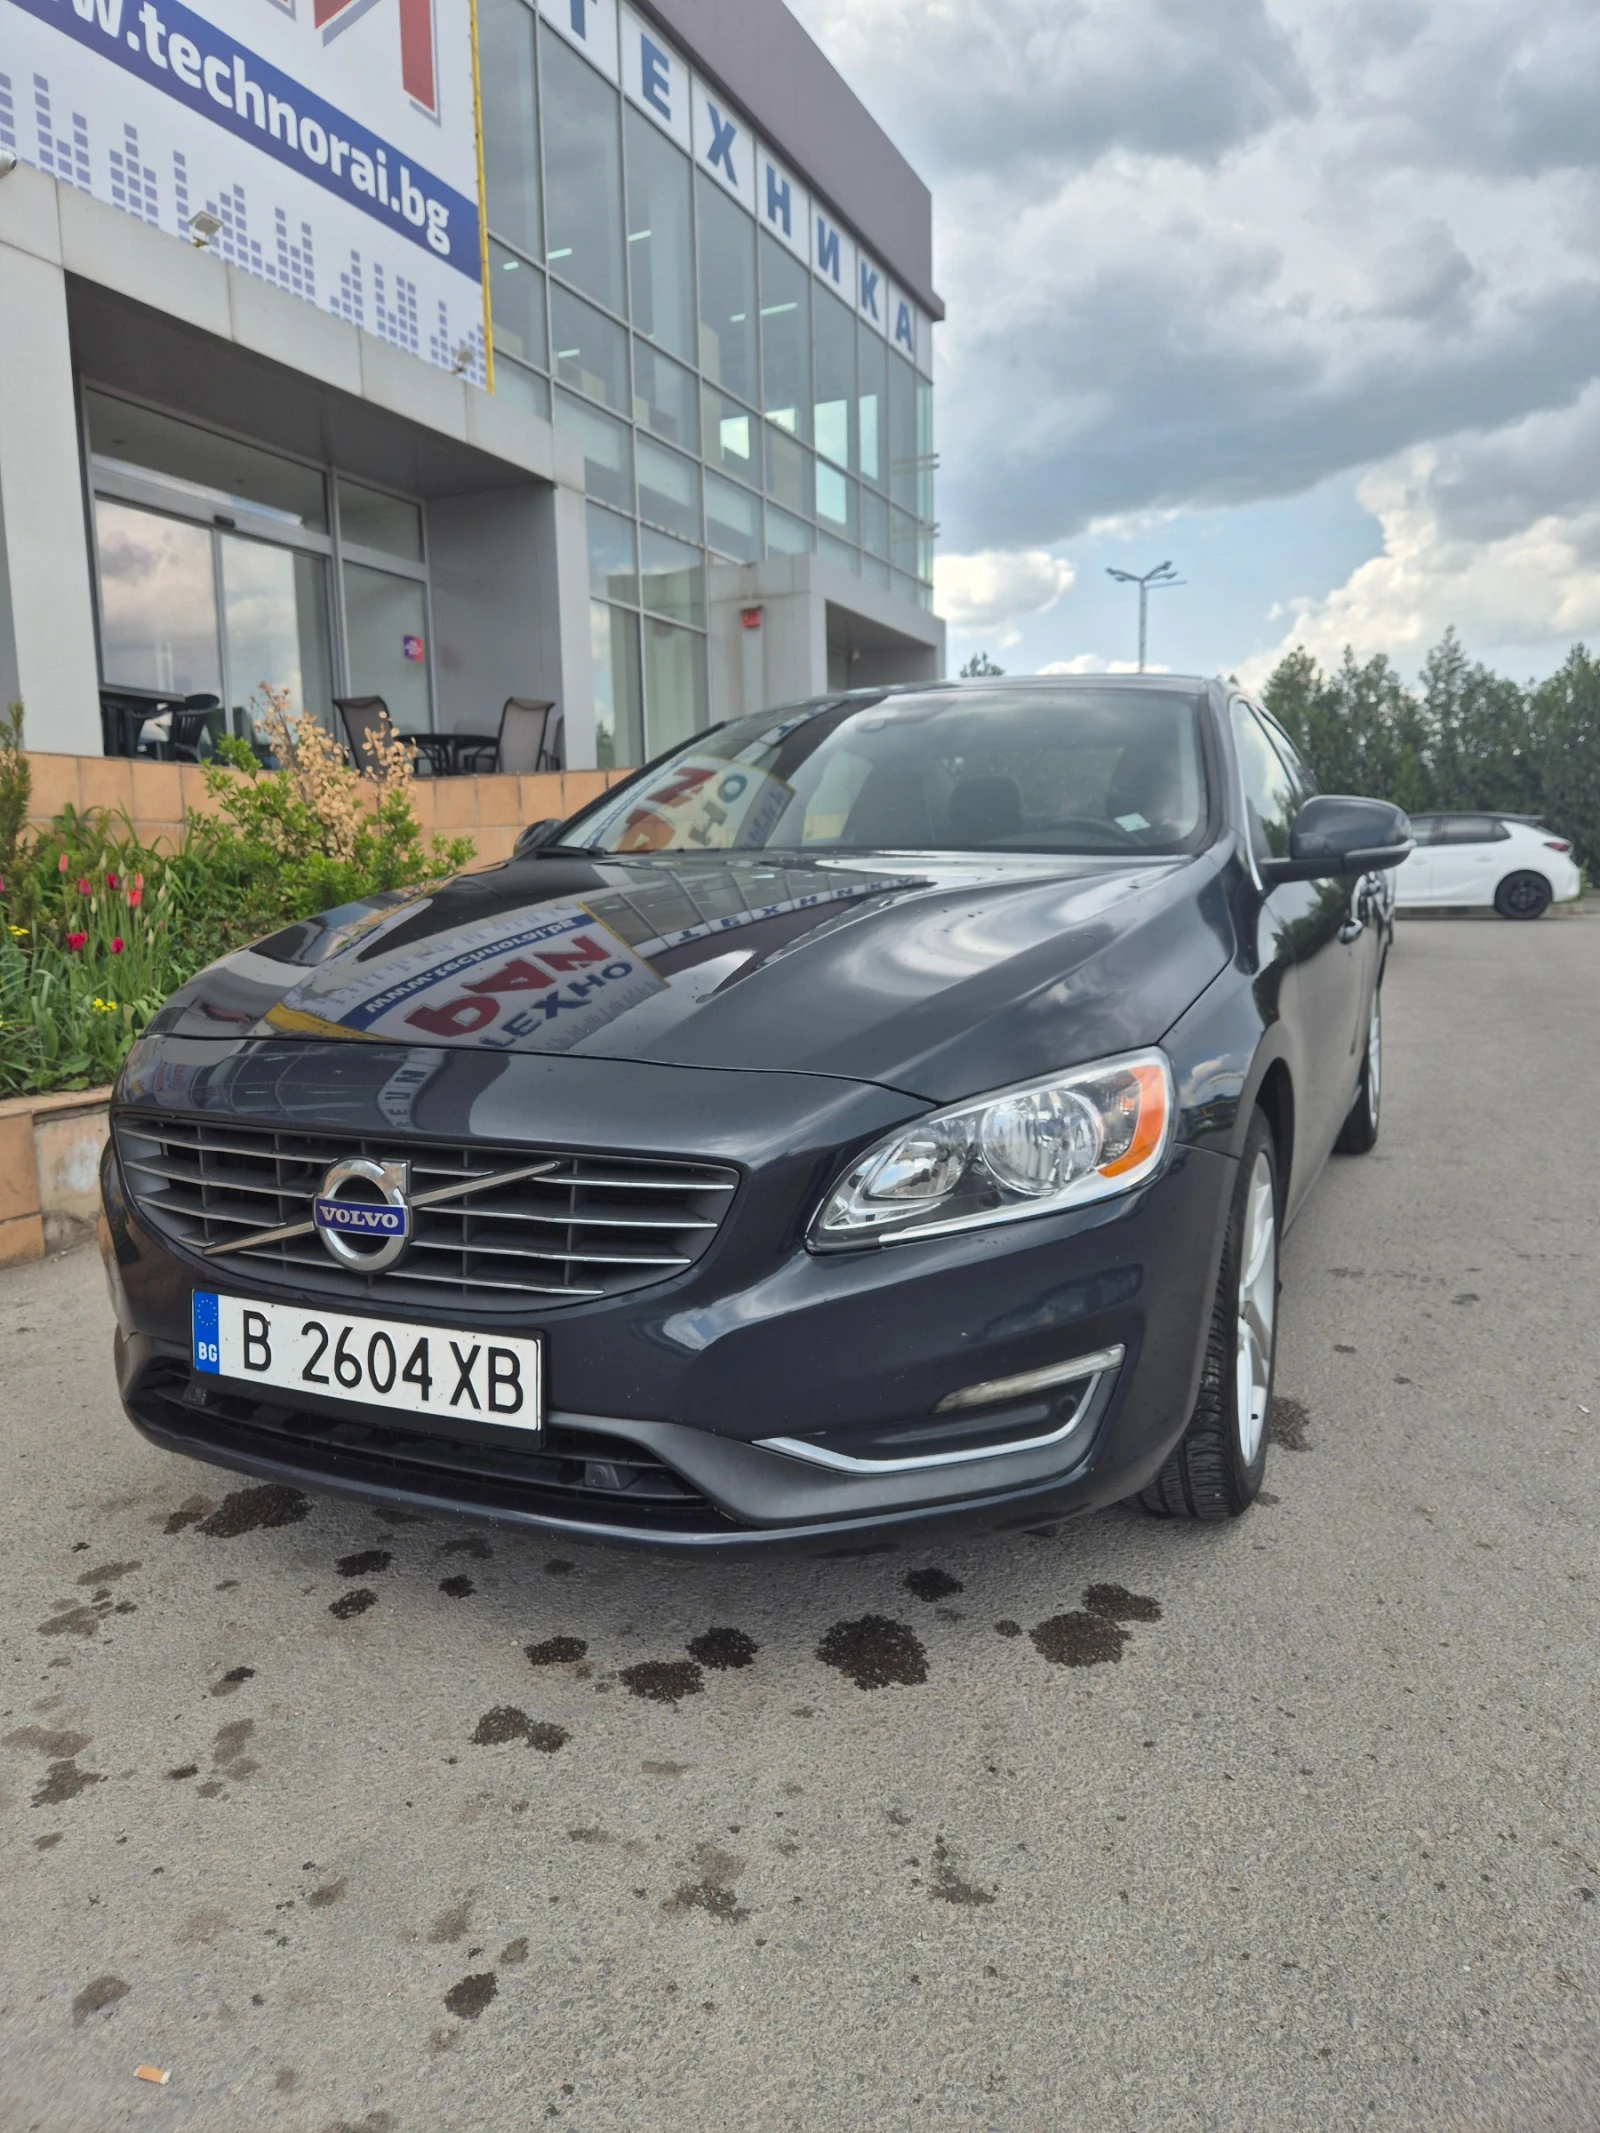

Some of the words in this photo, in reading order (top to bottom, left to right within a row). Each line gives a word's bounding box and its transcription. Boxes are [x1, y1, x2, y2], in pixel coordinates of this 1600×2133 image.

[52, 0, 451, 255] w.technorai.bg
[319, 1205, 399, 1229] VOLVO
[197, 1341, 218, 1363] BG
[242, 1309, 272, 1372] B
[300, 1320, 433, 1402] 2604
[448, 1340, 524, 1415] XB
